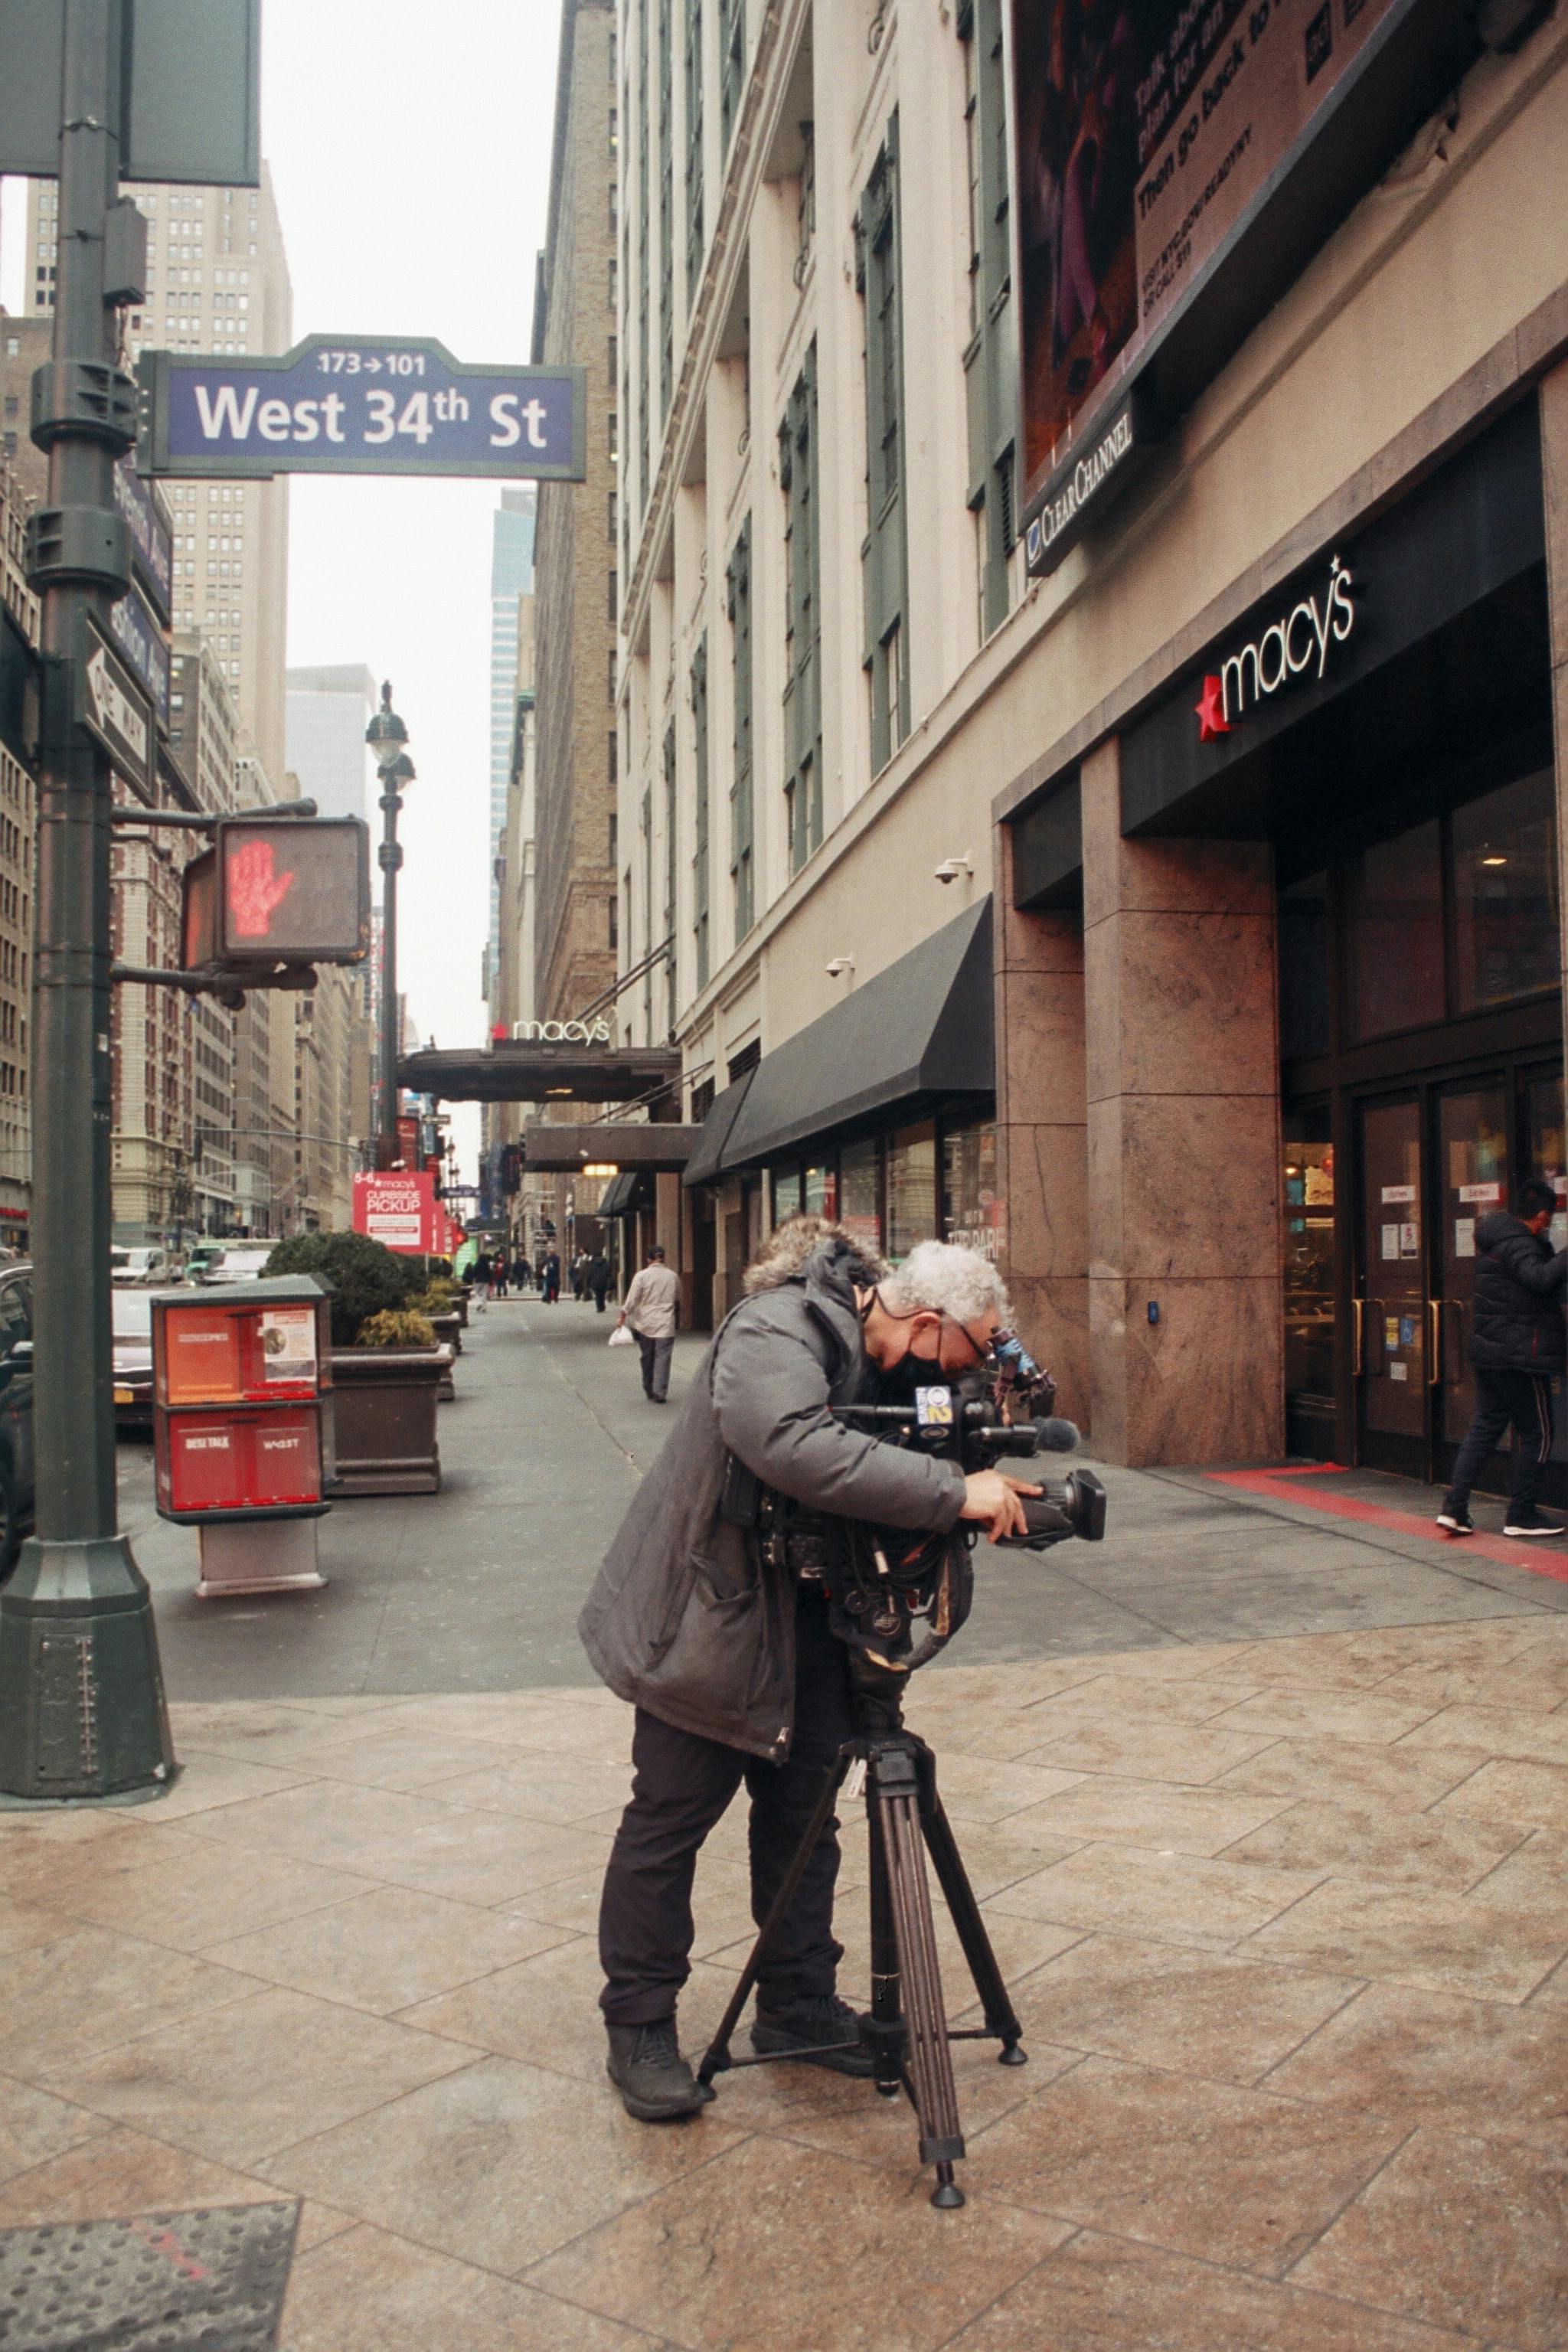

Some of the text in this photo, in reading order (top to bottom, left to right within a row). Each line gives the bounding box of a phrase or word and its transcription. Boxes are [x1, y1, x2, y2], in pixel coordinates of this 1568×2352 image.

[1138, 86, 1171, 165] plan
[1174, 40, 1197, 96] for
[1138, 3, 1269, 220] Then go back to
[318, 351, 426, 376] 173 101
[194, 385, 547, 448] West 34th St
[1221, 554, 1354, 722] macy's
[513, 1016, 610, 1047] macy's
[367, 1200, 420, 1212] PICKUP
[916, 1387, 927, 1424] NEWS
[929, 1405, 953, 1423] 2
